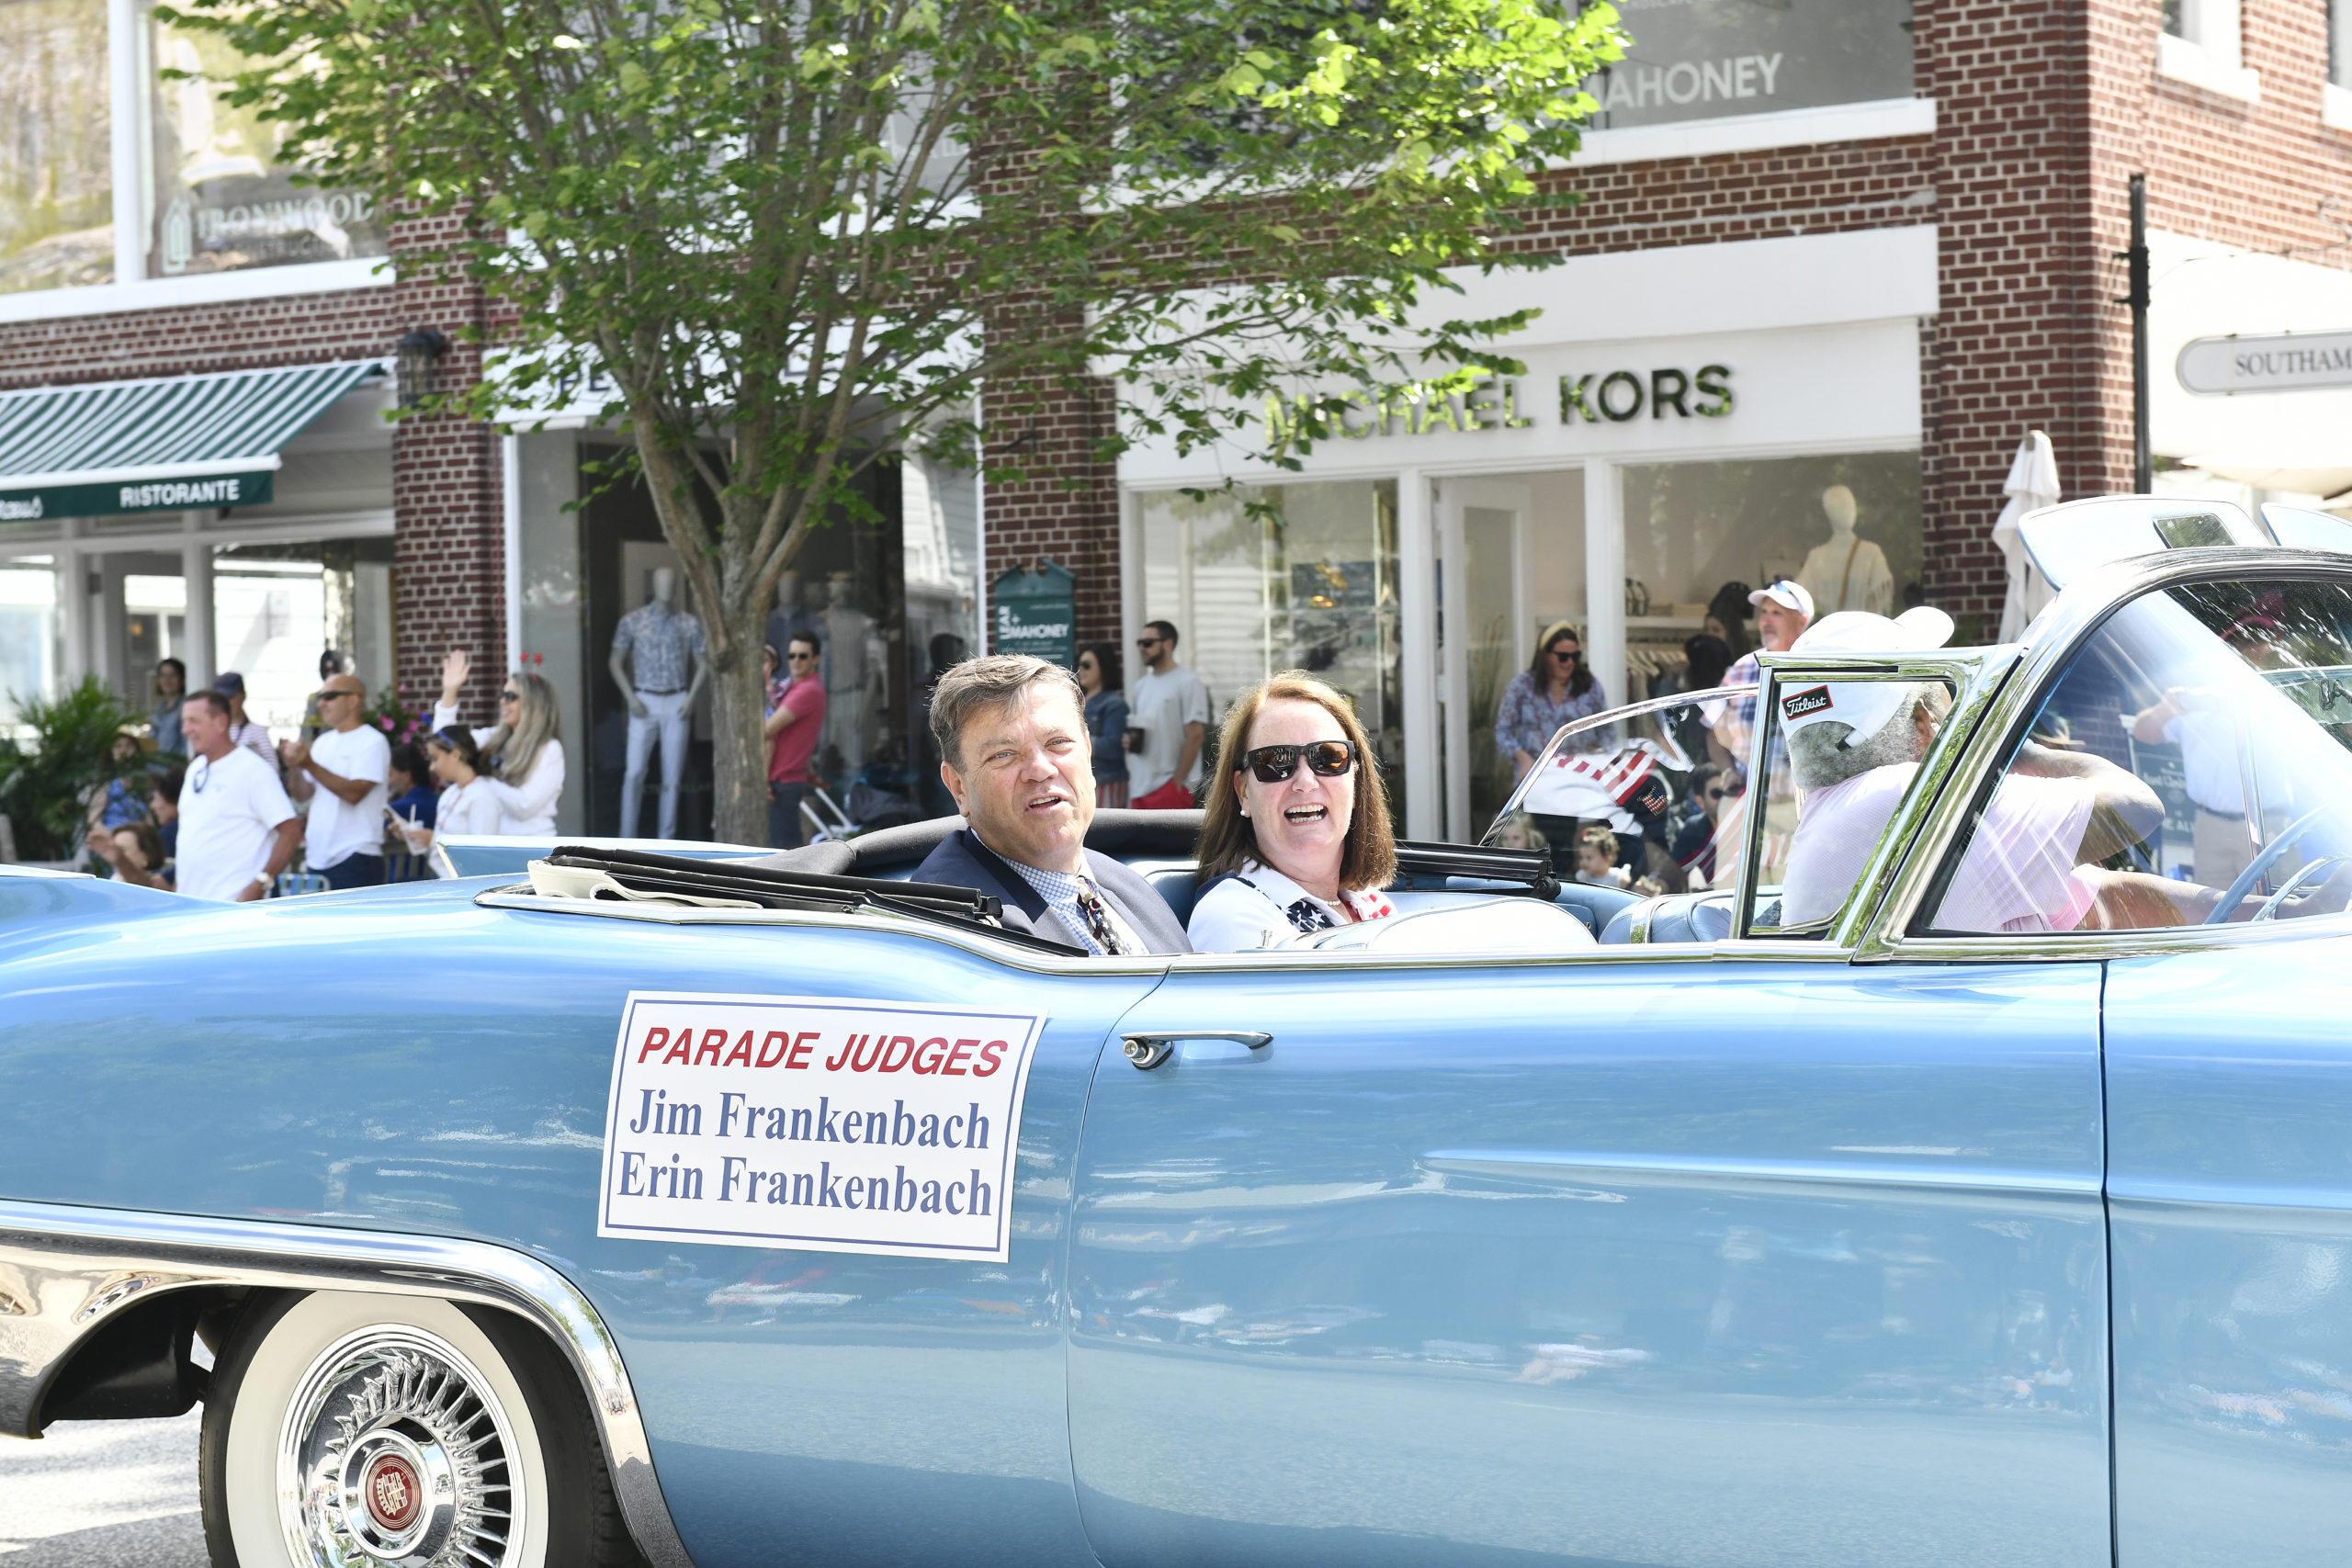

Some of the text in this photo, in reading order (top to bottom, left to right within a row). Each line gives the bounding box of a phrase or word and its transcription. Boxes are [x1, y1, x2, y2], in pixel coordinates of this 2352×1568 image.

[198, 190, 375, 240] IRONWOOD
[2234, 346, 2352, 377] SOUTHAM
[1265, 364, 1733, 445] MICHAEL KORS
[119, 479, 240, 508] RISTORANTE
[1010, 624, 1069, 639] MAHONEY
[1787, 696, 1826, 716] Titleist
[638, 1026, 1009, 1077] PARADE JUDGES
[629, 1088, 990, 1150] Jim Frankenbach
[616, 1151, 992, 1217] Erin Frankenbach
